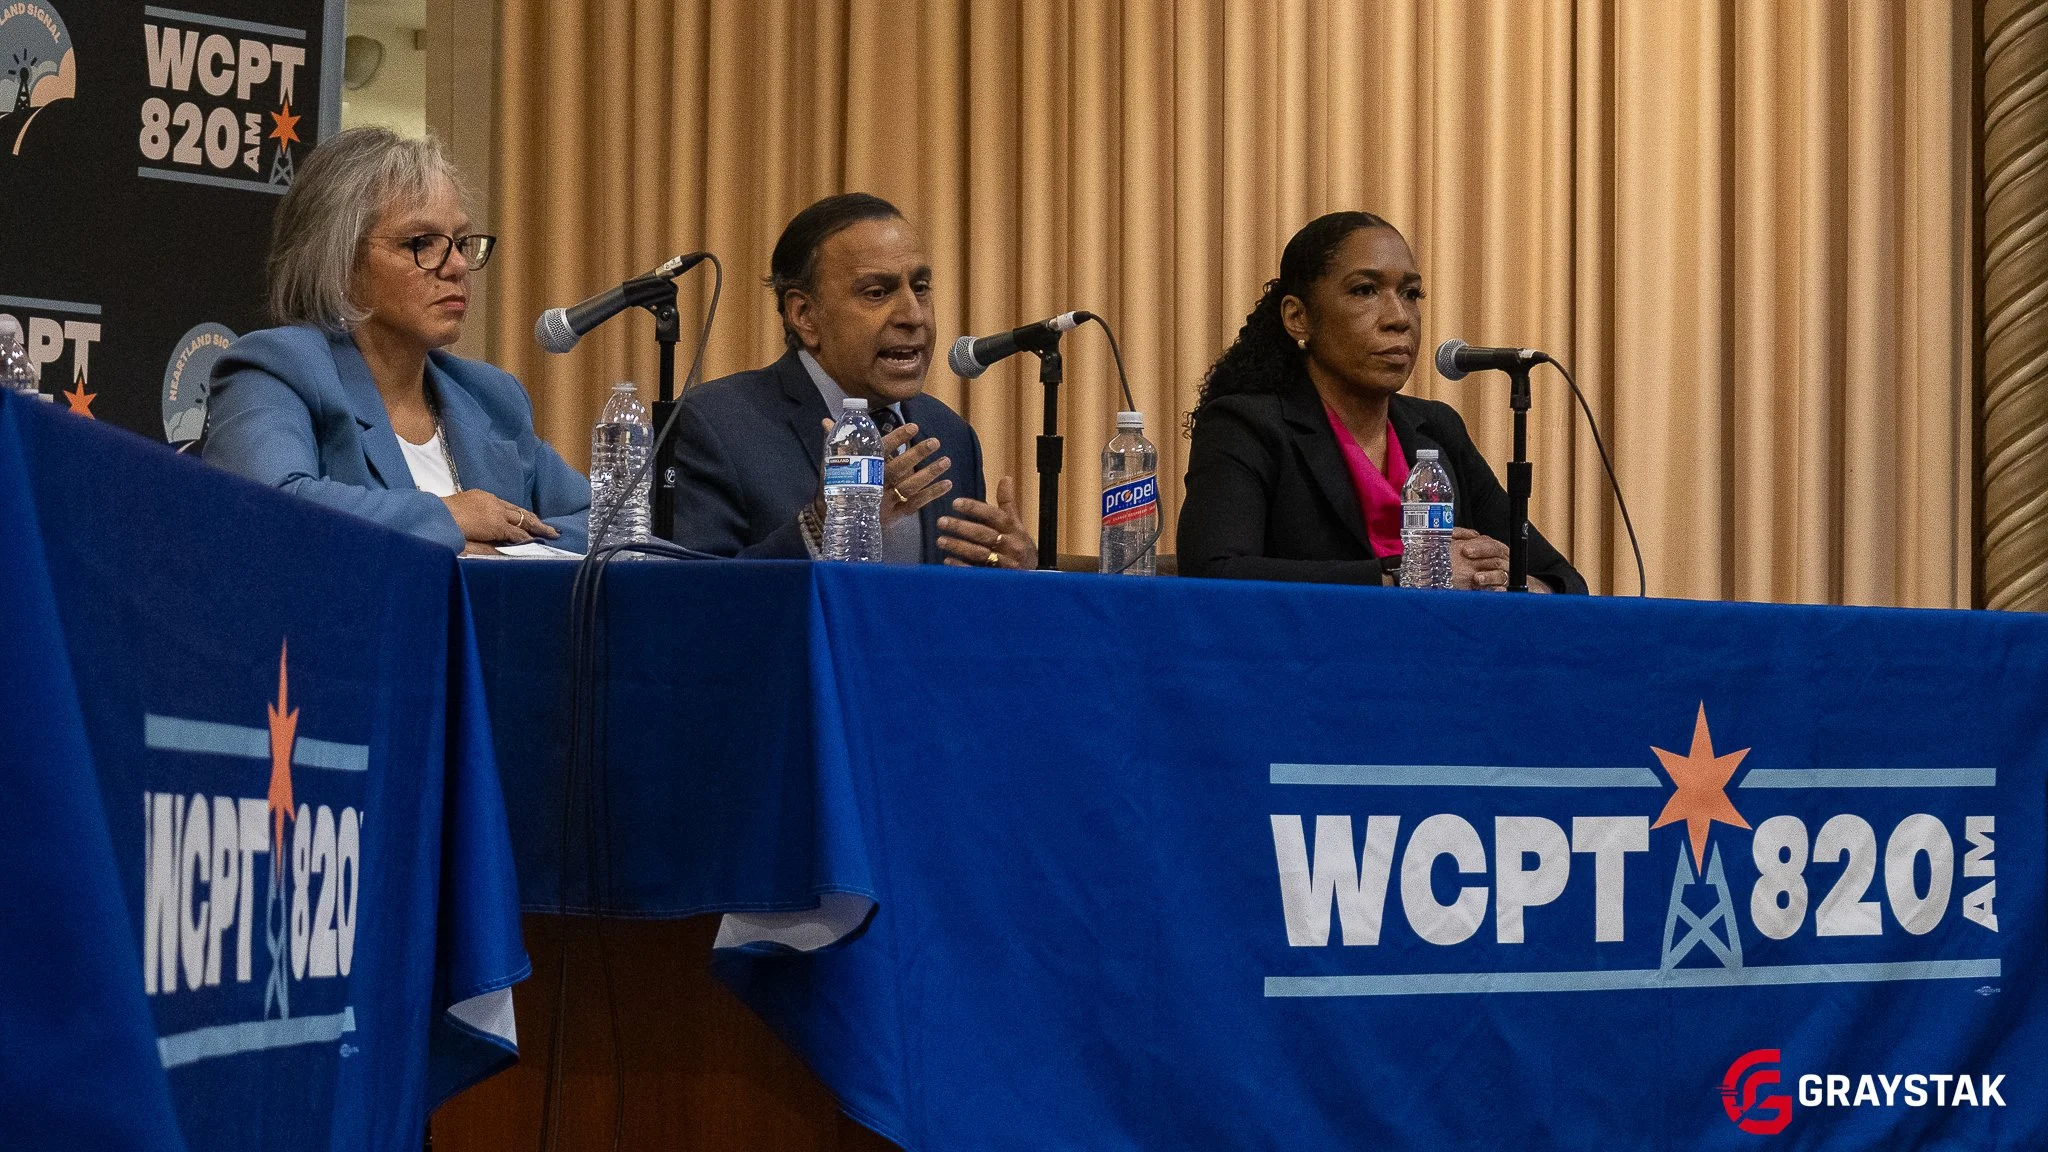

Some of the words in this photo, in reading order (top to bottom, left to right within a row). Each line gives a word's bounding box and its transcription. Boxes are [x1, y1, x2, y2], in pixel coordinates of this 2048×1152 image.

[27, 4, 61, 44] SIGNAL
[144, 24, 306, 106] WCPT
[139, 97, 240, 169] 820
[243, 112, 261, 173] AM
[169, 333, 212, 401] HEARTLAND
[213, 334, 233, 349] SIG
[1106, 478, 1154, 513] propel
[144, 791, 271, 995] WCPT
[291, 803, 360, 981] 820
[1269, 814, 1651, 947] WCPT
[1750, 814, 1955, 941] 820
[1962, 815, 1999, 933] AM
